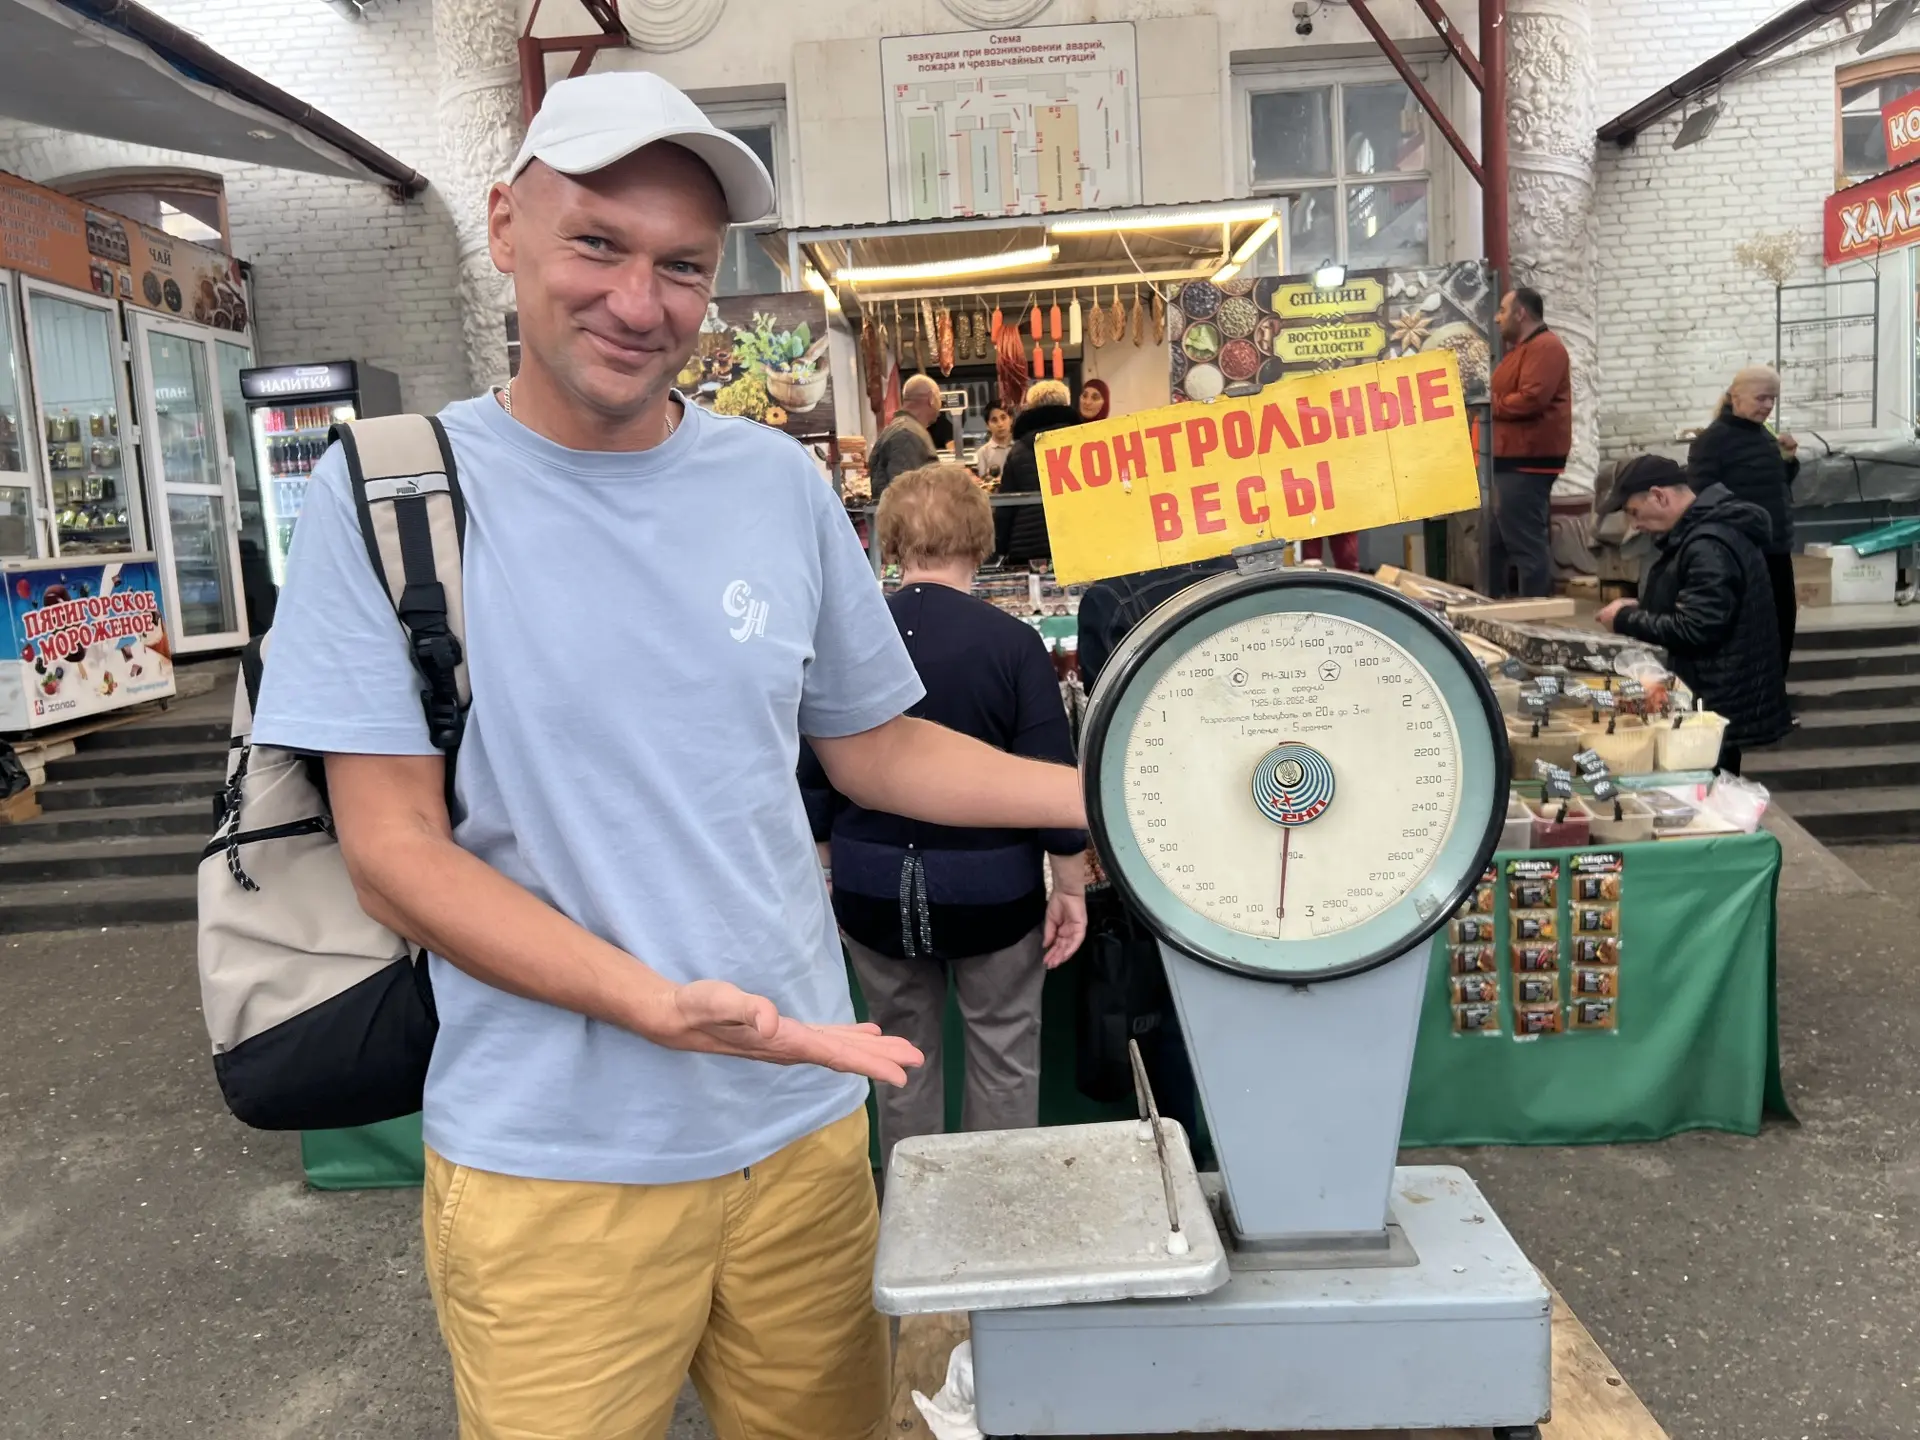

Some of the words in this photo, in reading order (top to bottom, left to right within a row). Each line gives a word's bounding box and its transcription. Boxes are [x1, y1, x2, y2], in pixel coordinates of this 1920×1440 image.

[989, 34, 1022, 45] Схема
[907, 50, 960, 63] эвакуации
[963, 48, 982, 59] при
[984, 43, 1062, 57] возникновении
[918, 60, 956, 73] пожара
[959, 61, 966, 69] и
[967, 55, 1044, 70] чрезвычайных
[1048, 52, 1097, 65] ситуаций
[149, 248, 172, 266] ЧАЙ
[1290, 288, 1366, 306] СПЕЦИИ
[1288, 328, 1372, 343] ВОСТОЧНЫЕ
[1294, 341, 1364, 356] СЛАДОСТИ
[260, 375, 332, 393] НАПИТКИ
[1045, 368, 1454, 496] КОНТРОЛЬНЫЕ
[1150, 460, 1334, 542] ВЕСЫ
[24, 592, 157, 638] ПЯТИГОРСКОЕ
[38, 613, 155, 665] МОРОЖЕНОЕ
[1270, 638, 1295, 648] 1500
[1300, 638, 1325, 648] 1600
[1242, 642, 1266, 652] 1400
[1328, 645, 1352, 655] 1700
[1214, 652, 1239, 662] 1300
[1354, 658, 1378, 667] 1800
[1190, 668, 1214, 678] 1200
[1377, 674, 1401, 684] 1900
[1169, 688, 1193, 698] 1100
[1292, 684, 1325, 693] средний
[1402, 694, 1413, 707] 2
[1162, 710, 1166, 722] 1
[1406, 721, 1432, 730] 2100
[1247, 726, 1279, 736] деление
[1145, 737, 1164, 746] 900
[1414, 748, 1440, 757] 2200
[1140, 765, 1159, 774] 800
[1416, 775, 1442, 785] 2300
[1142, 792, 1160, 800] 700
[1412, 802, 1438, 812] 2400
[1148, 819, 1166, 827] 600
[1402, 828, 1428, 837] 2500
[1160, 843, 1178, 852] 500
[1388, 852, 1414, 861] 2600
[1176, 864, 1194, 873] 400
[1369, 872, 1394, 881] 2700
[1196, 882, 1215, 891] 300
[1347, 888, 1373, 897] 2800
[1219, 896, 1238, 904] 200
[1323, 900, 1348, 908] 2900
[1246, 904, 1263, 912] 100
[1276, 907, 1284, 919] 0
[1305, 905, 1315, 917] 3
